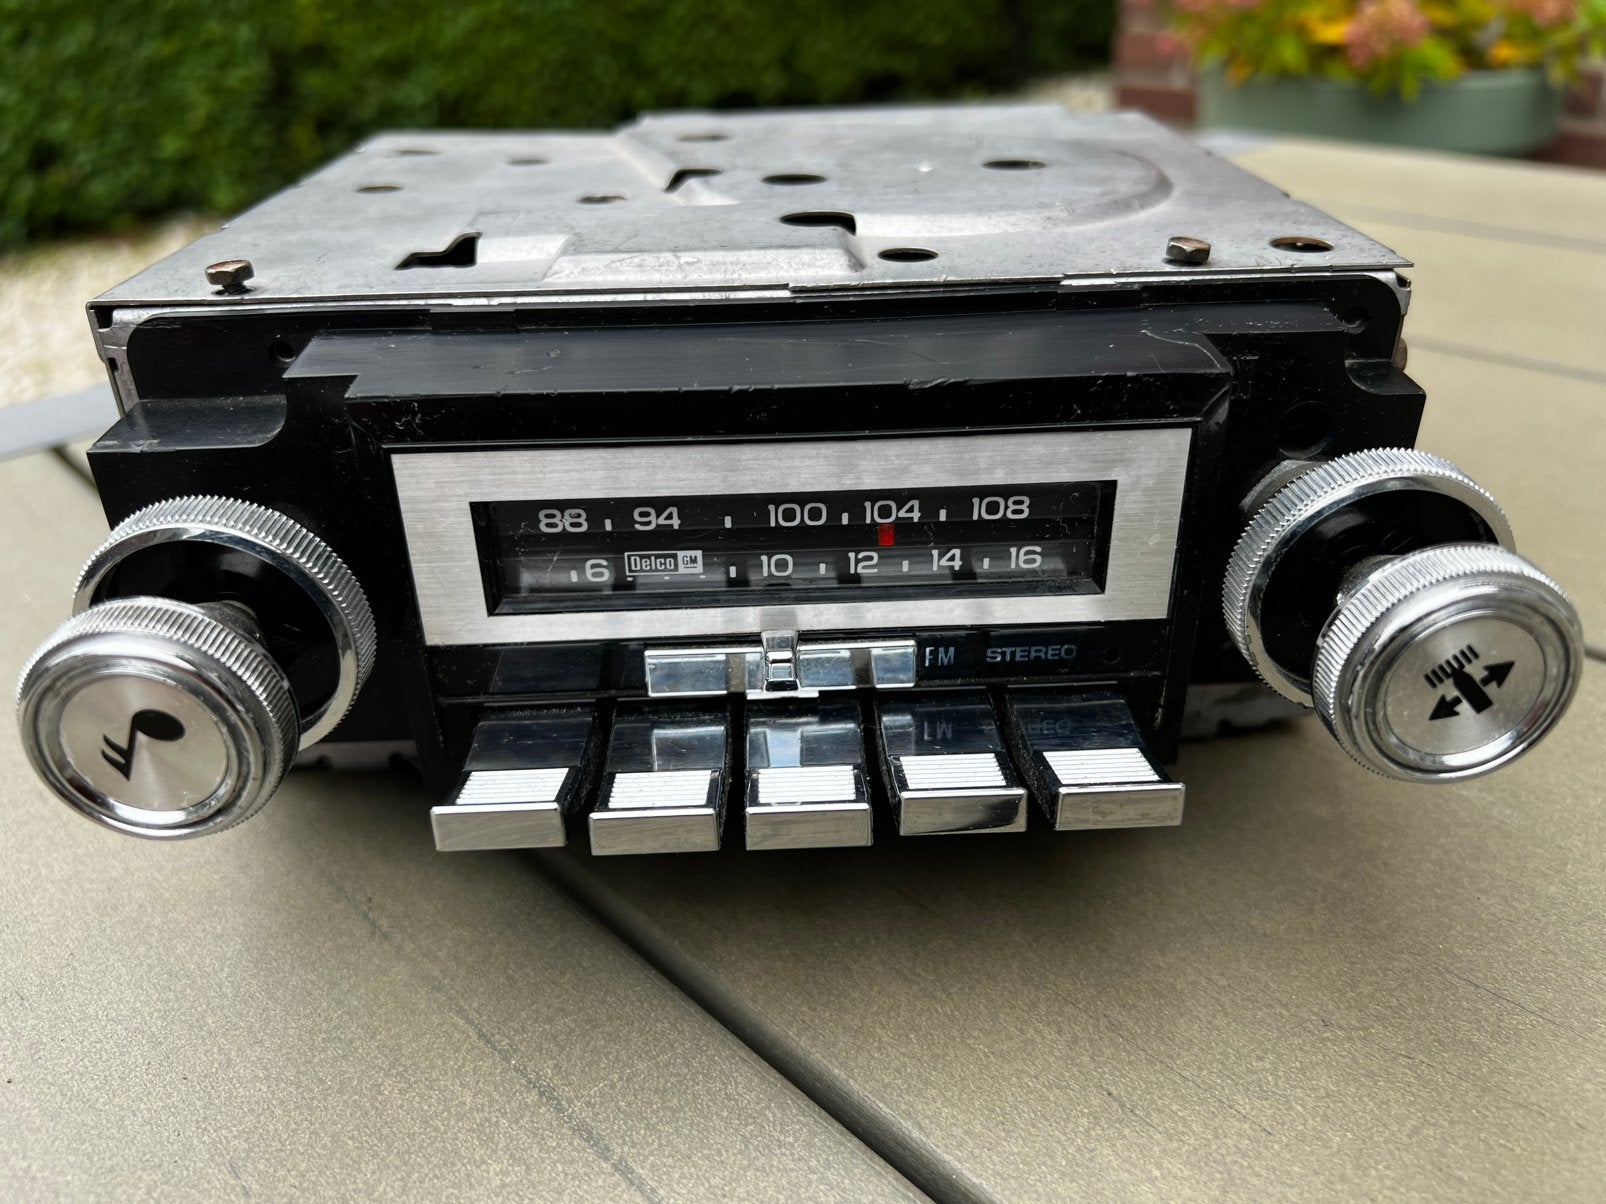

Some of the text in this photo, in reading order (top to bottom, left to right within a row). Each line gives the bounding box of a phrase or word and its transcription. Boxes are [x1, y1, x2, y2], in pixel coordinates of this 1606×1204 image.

[538, 496, 1029, 533] 88 94 100 104 108
[585, 546, 1042, 582] 6 10 12 14 16
[630, 554, 675, 572] Delco
[682, 555, 698, 568] GM
[925, 644, 1078, 666] FM STEREO
